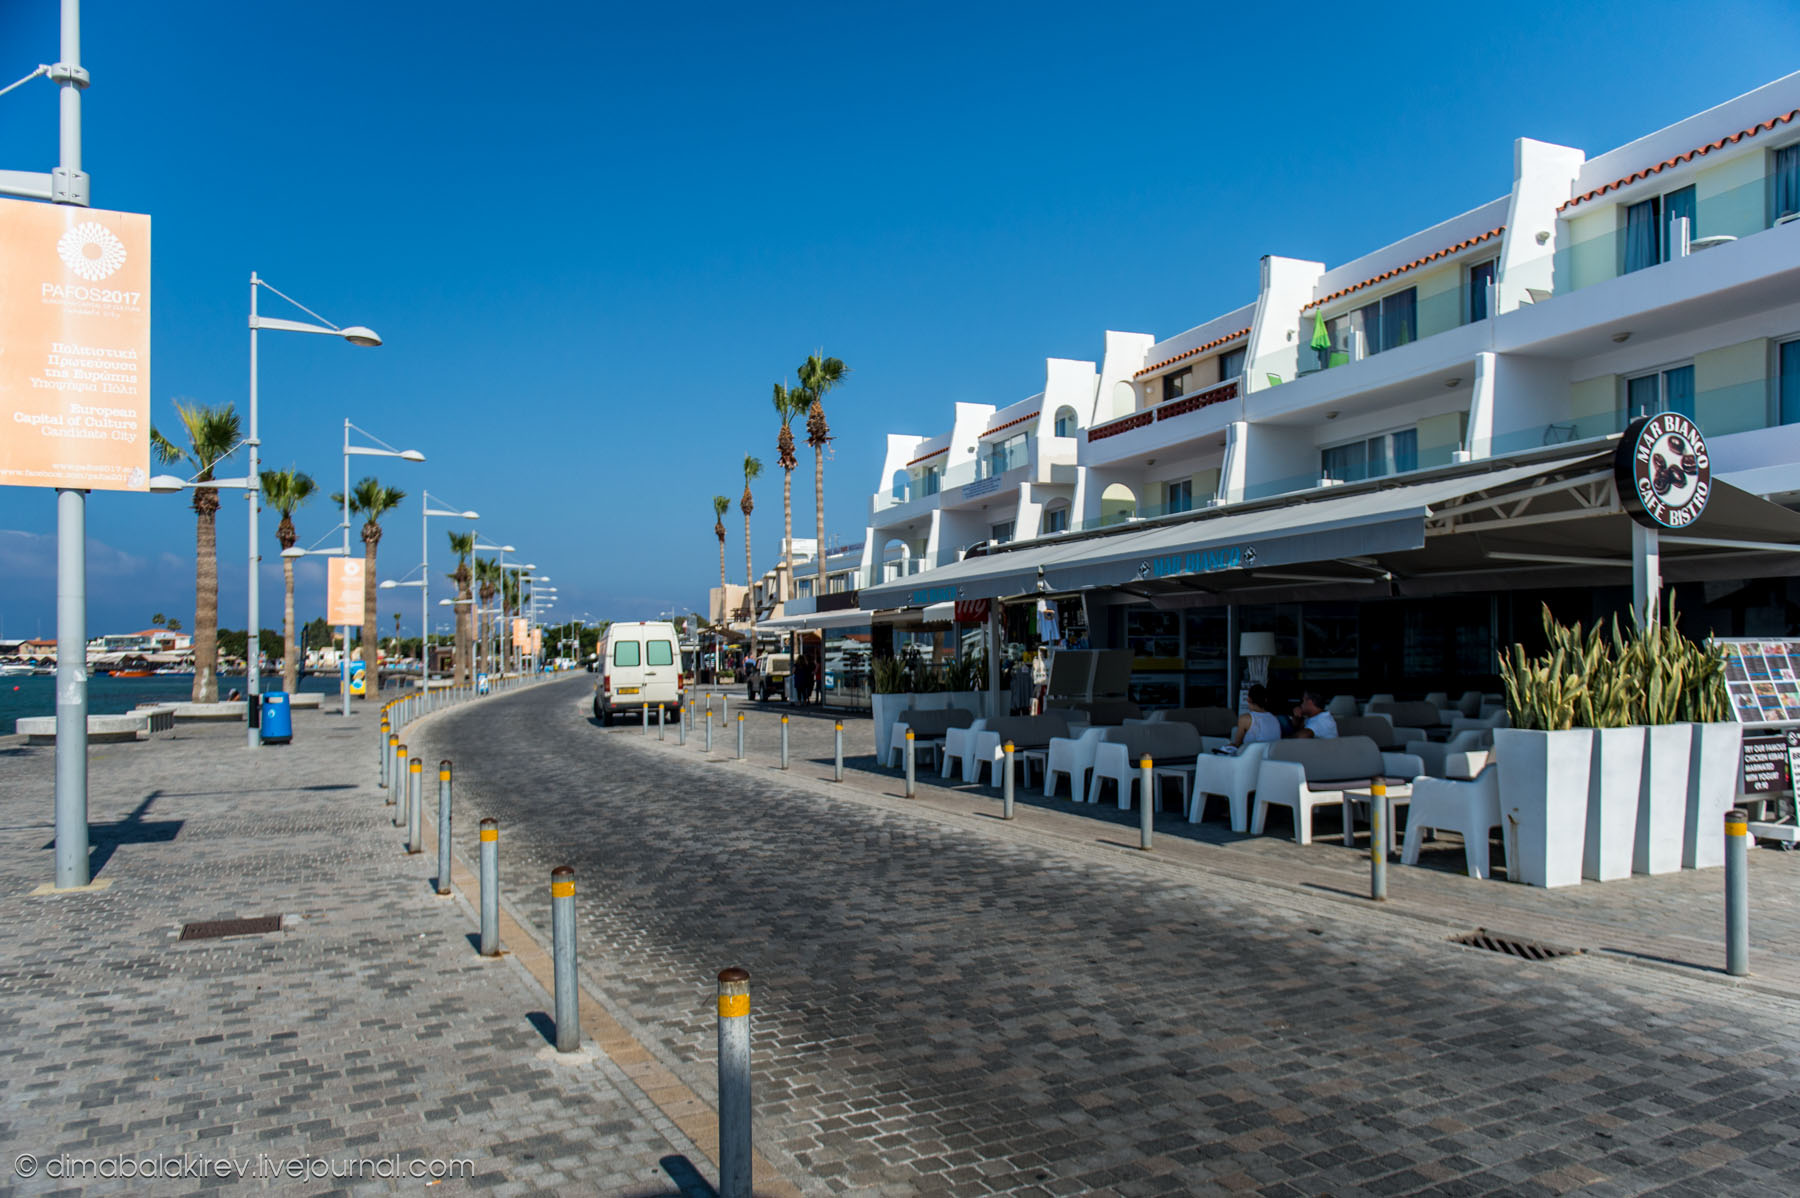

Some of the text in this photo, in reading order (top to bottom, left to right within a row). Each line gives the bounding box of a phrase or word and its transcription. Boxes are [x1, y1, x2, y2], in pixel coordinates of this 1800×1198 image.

[41, 282, 141, 304] PAFOS2017
[51, 342, 137, 359] Πολιτιστική
[72, 368, 137, 384] Ευρώπης
[102, 383, 137, 394] Πόλη
[70, 403, 137, 418] European
[13, 411, 137, 430] Capital of Culture
[41, 426, 137, 444] Candidate City
[1637, 415, 1709, 469] MAR BIANCO
[1638, 477, 1709, 526] CAFÉ BISTRO
[1153, 546, 1241, 577] MAR BIANCO
